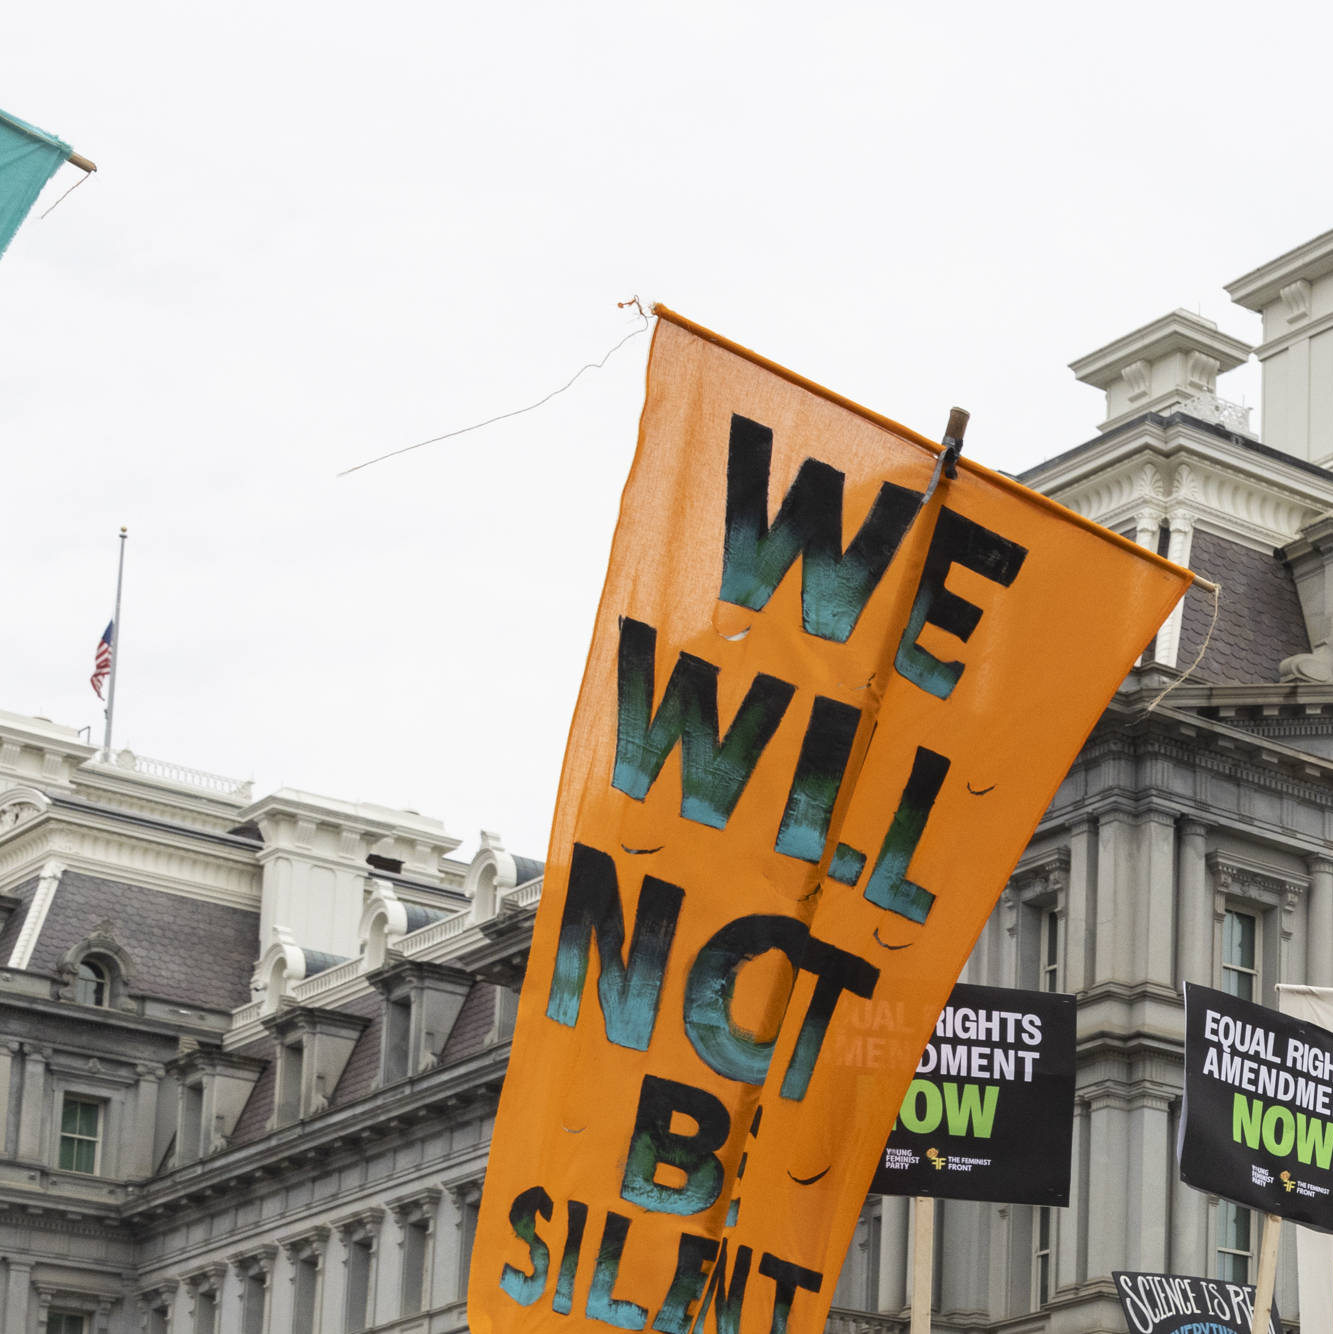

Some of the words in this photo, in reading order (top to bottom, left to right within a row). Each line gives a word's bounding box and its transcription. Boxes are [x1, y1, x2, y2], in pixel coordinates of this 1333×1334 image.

[719, 413, 1029, 701] WE
[546, 842, 880, 1102] NOT
[1204, 1009, 1282, 1064] EQUAL
[892, 1079, 1000, 1139] OW
[621, 1074, 763, 1228] B
[886, 1155, 920, 1164] FEMINIST
[886, 1162, 909, 1170] PARTY
[948, 1156, 960, 1164] THE
[961, 1157, 991, 1166] FEMINIST
[948, 1163, 972, 1172] FRONT
[1252, 1170, 1274, 1184] FEMINIST
[1252, 1176, 1267, 1187] PARTY
[1296, 1188, 1316, 1198] FRONT
[1297, 1181, 1306, 1189] THE
[1306, 1182, 1330, 1196] FEMINIST
[1119, 1275, 1201, 1334] SCIENCE
[1201, 1280, 1231, 1325] IS
